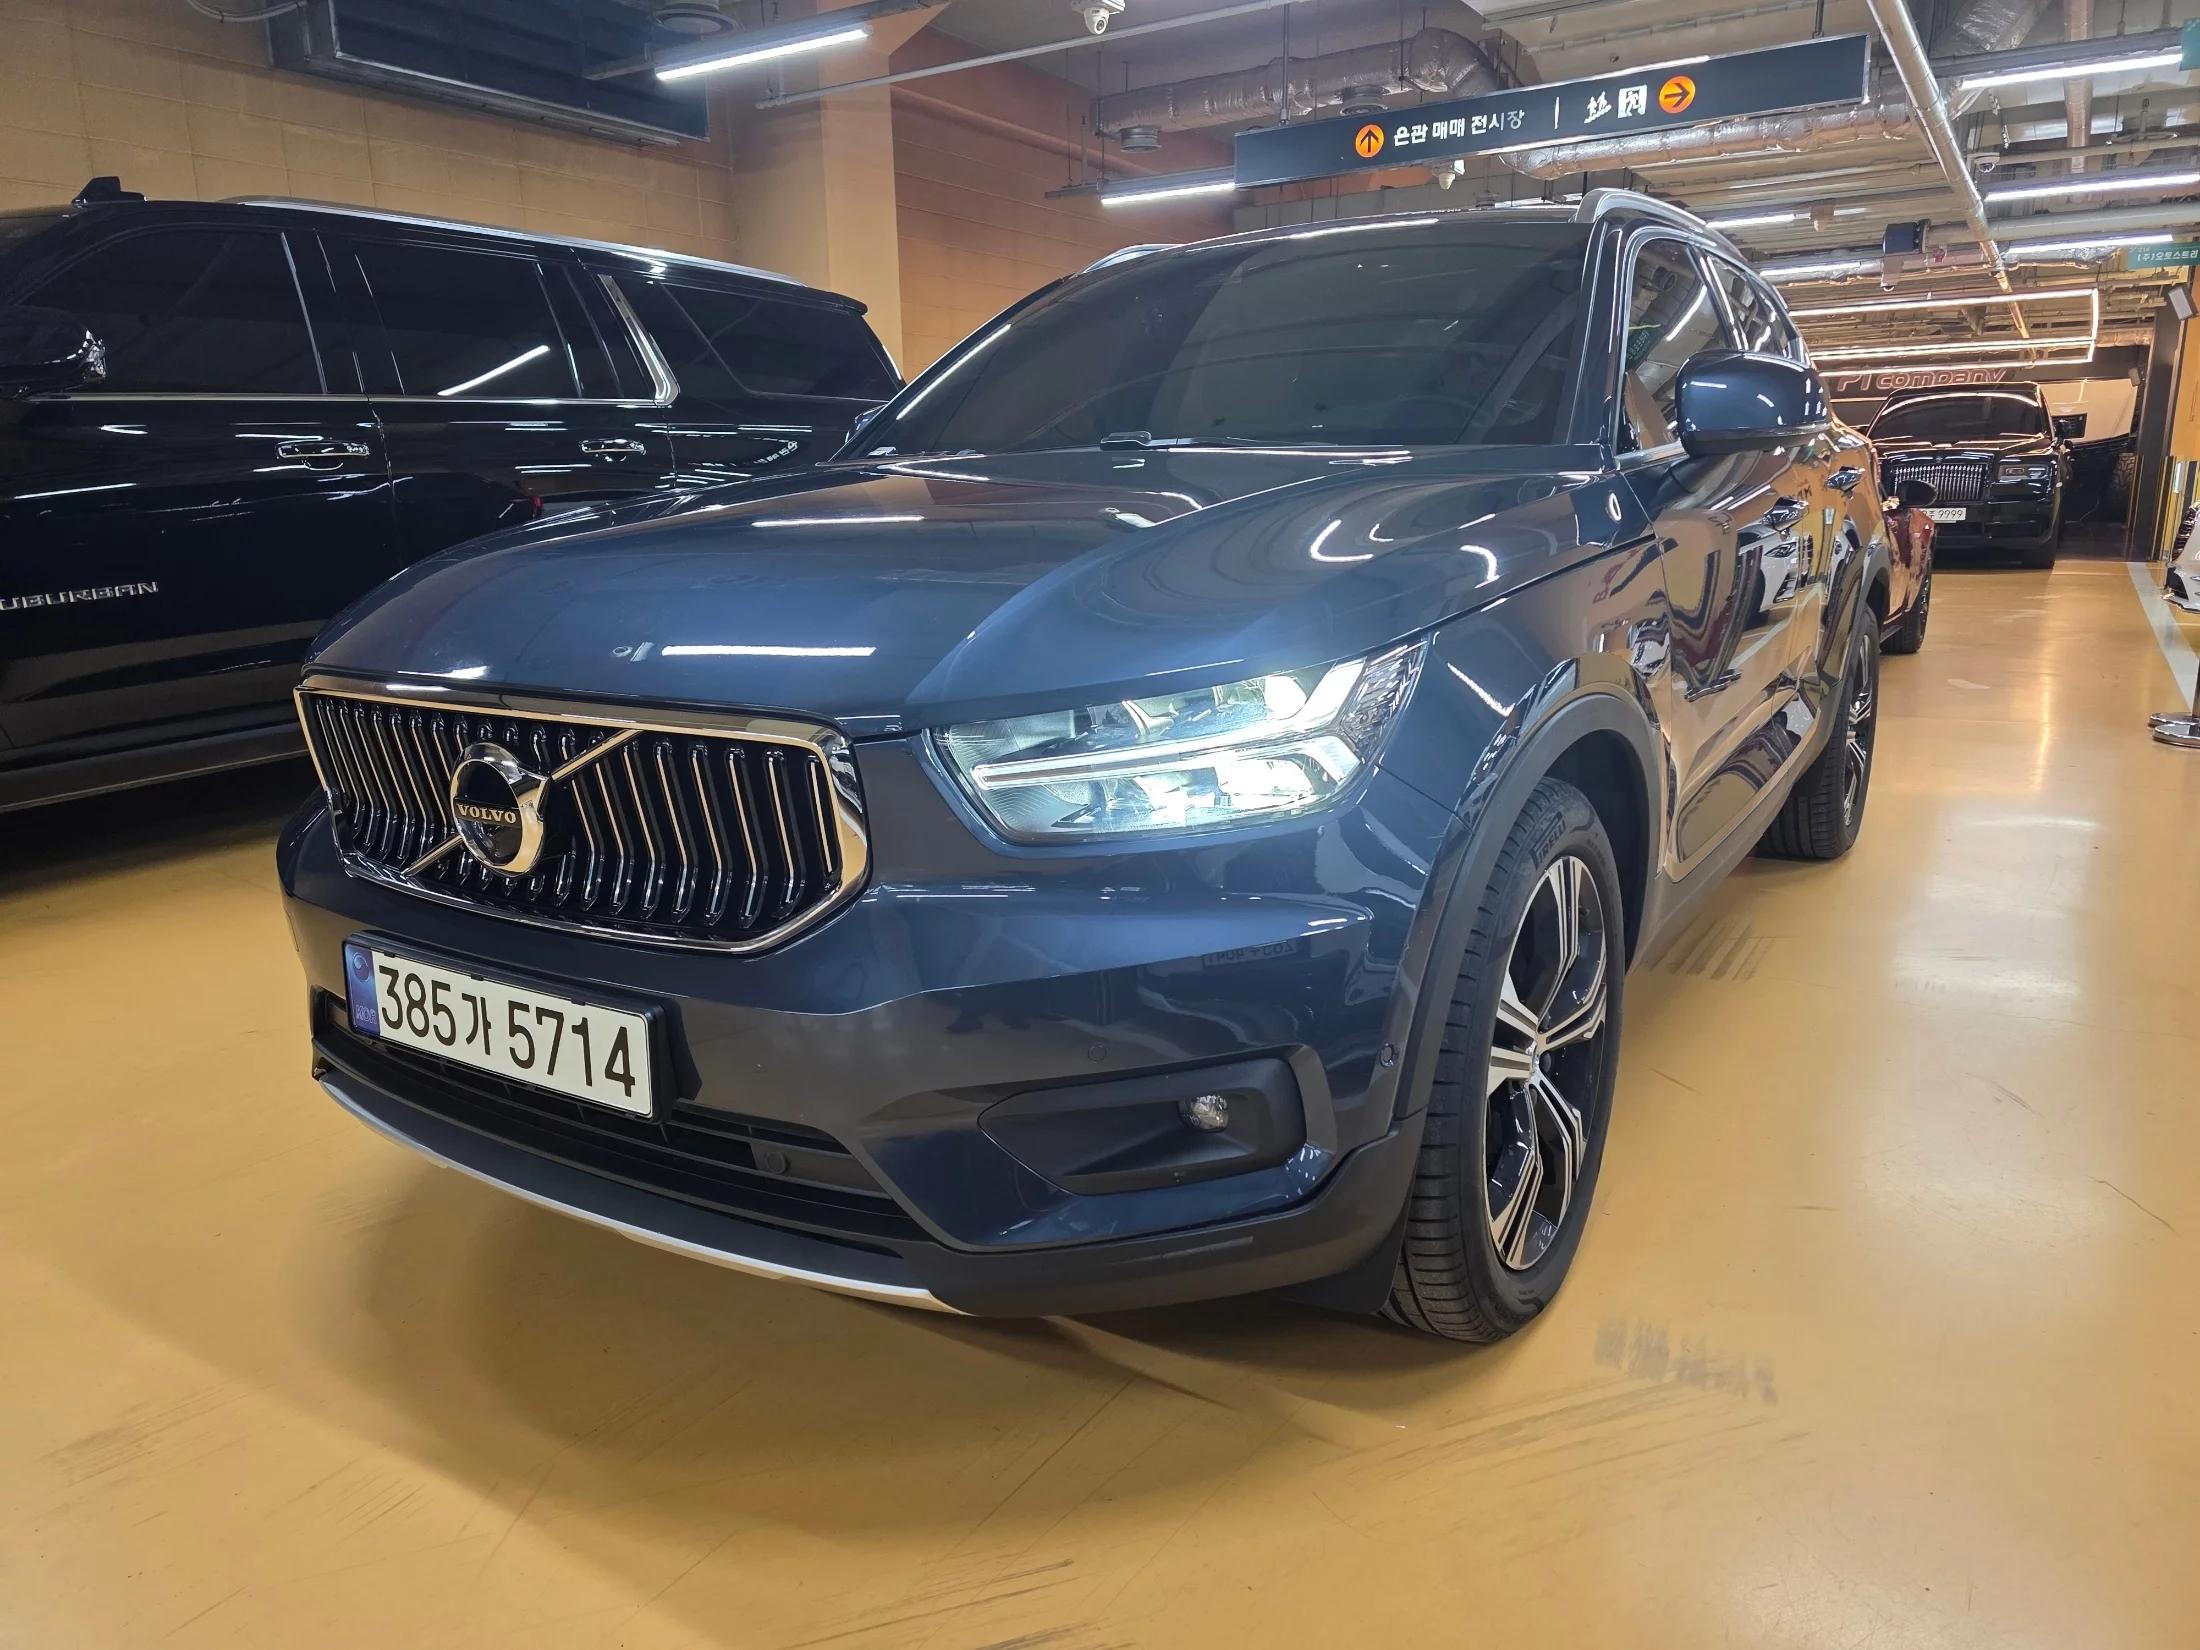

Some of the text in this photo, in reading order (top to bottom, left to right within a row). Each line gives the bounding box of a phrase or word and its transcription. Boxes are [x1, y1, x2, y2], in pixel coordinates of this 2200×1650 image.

[1432, 118, 1466, 140] 매매
[1471, 109, 1525, 135] 전시장
[1876, 368, 2007, 390] company
[456, 803, 517, 824] VOLVO
[378, 964, 636, 1098] 385가 5714
